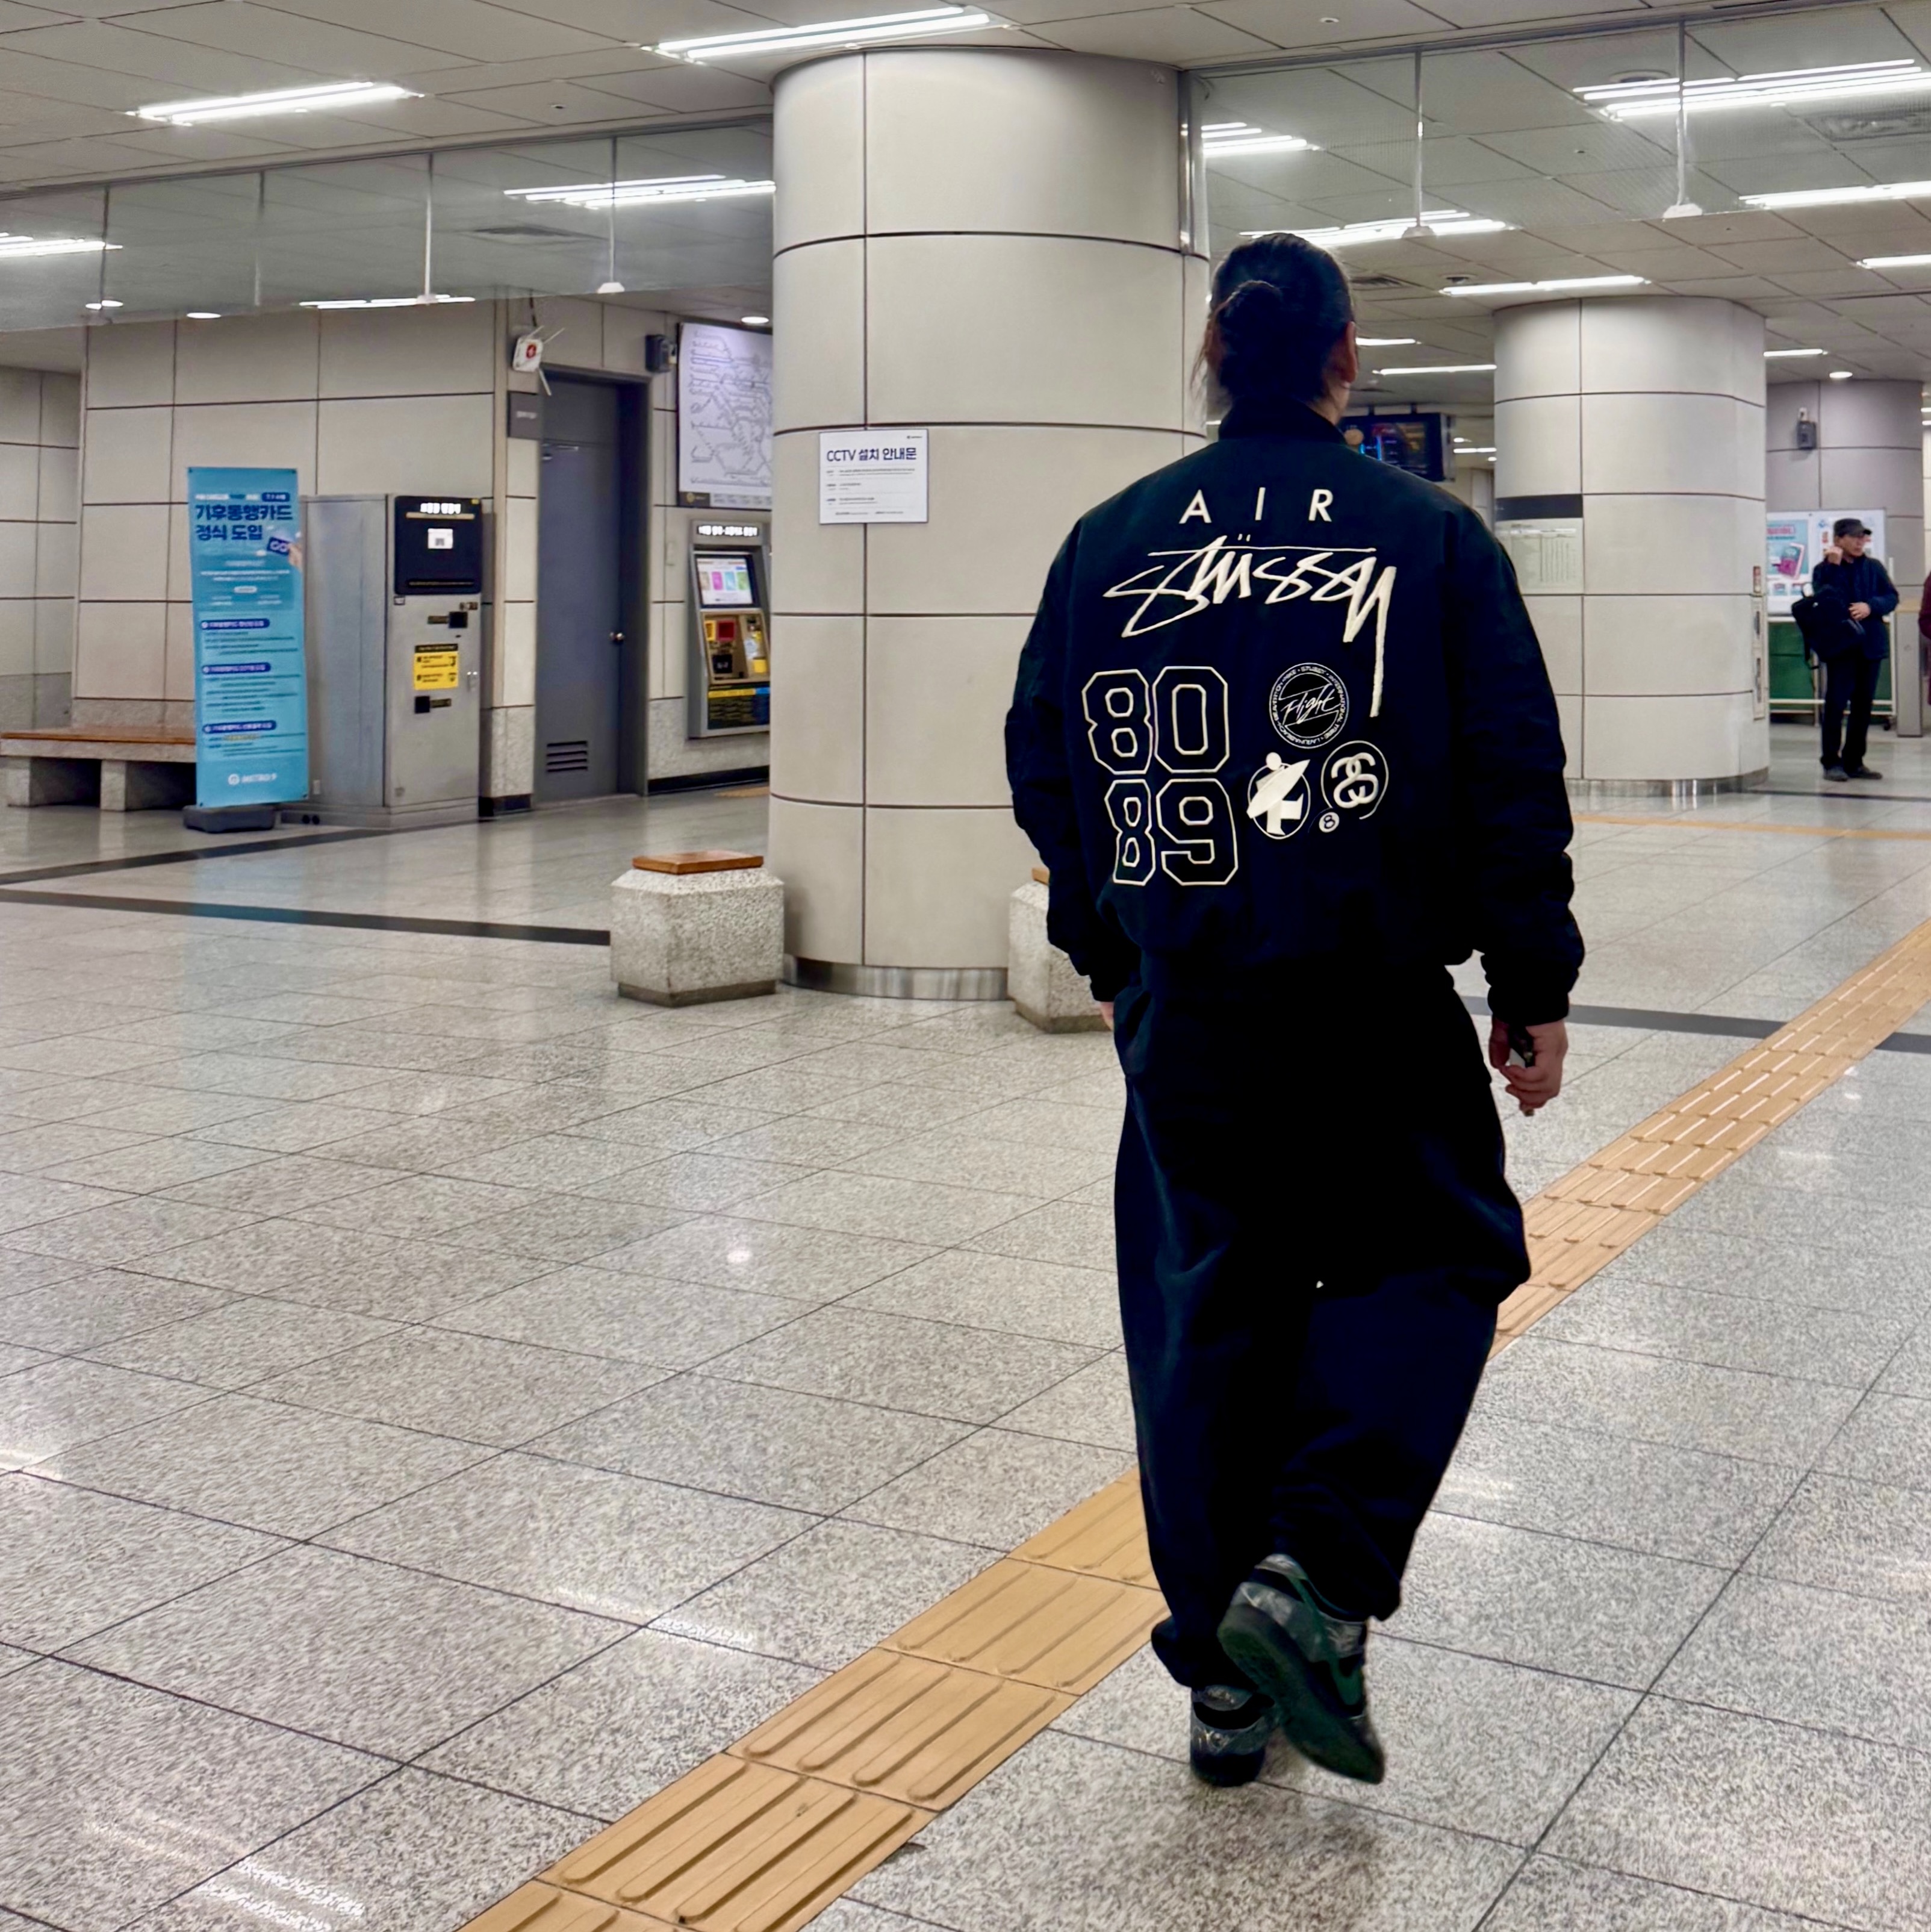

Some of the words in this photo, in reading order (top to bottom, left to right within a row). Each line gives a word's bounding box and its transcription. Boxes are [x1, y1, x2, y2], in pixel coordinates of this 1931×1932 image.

[827, 450, 856, 462] CCTV
[859, 449, 879, 461] 설치
[883, 447, 916, 461] 안내문
[194, 504, 293, 521] 기후동행카드
[195, 524, 227, 541] 정식
[231, 525, 263, 540] 도입
[1082, 666, 1230, 774] 80
[1104, 778, 1239, 886] 89
